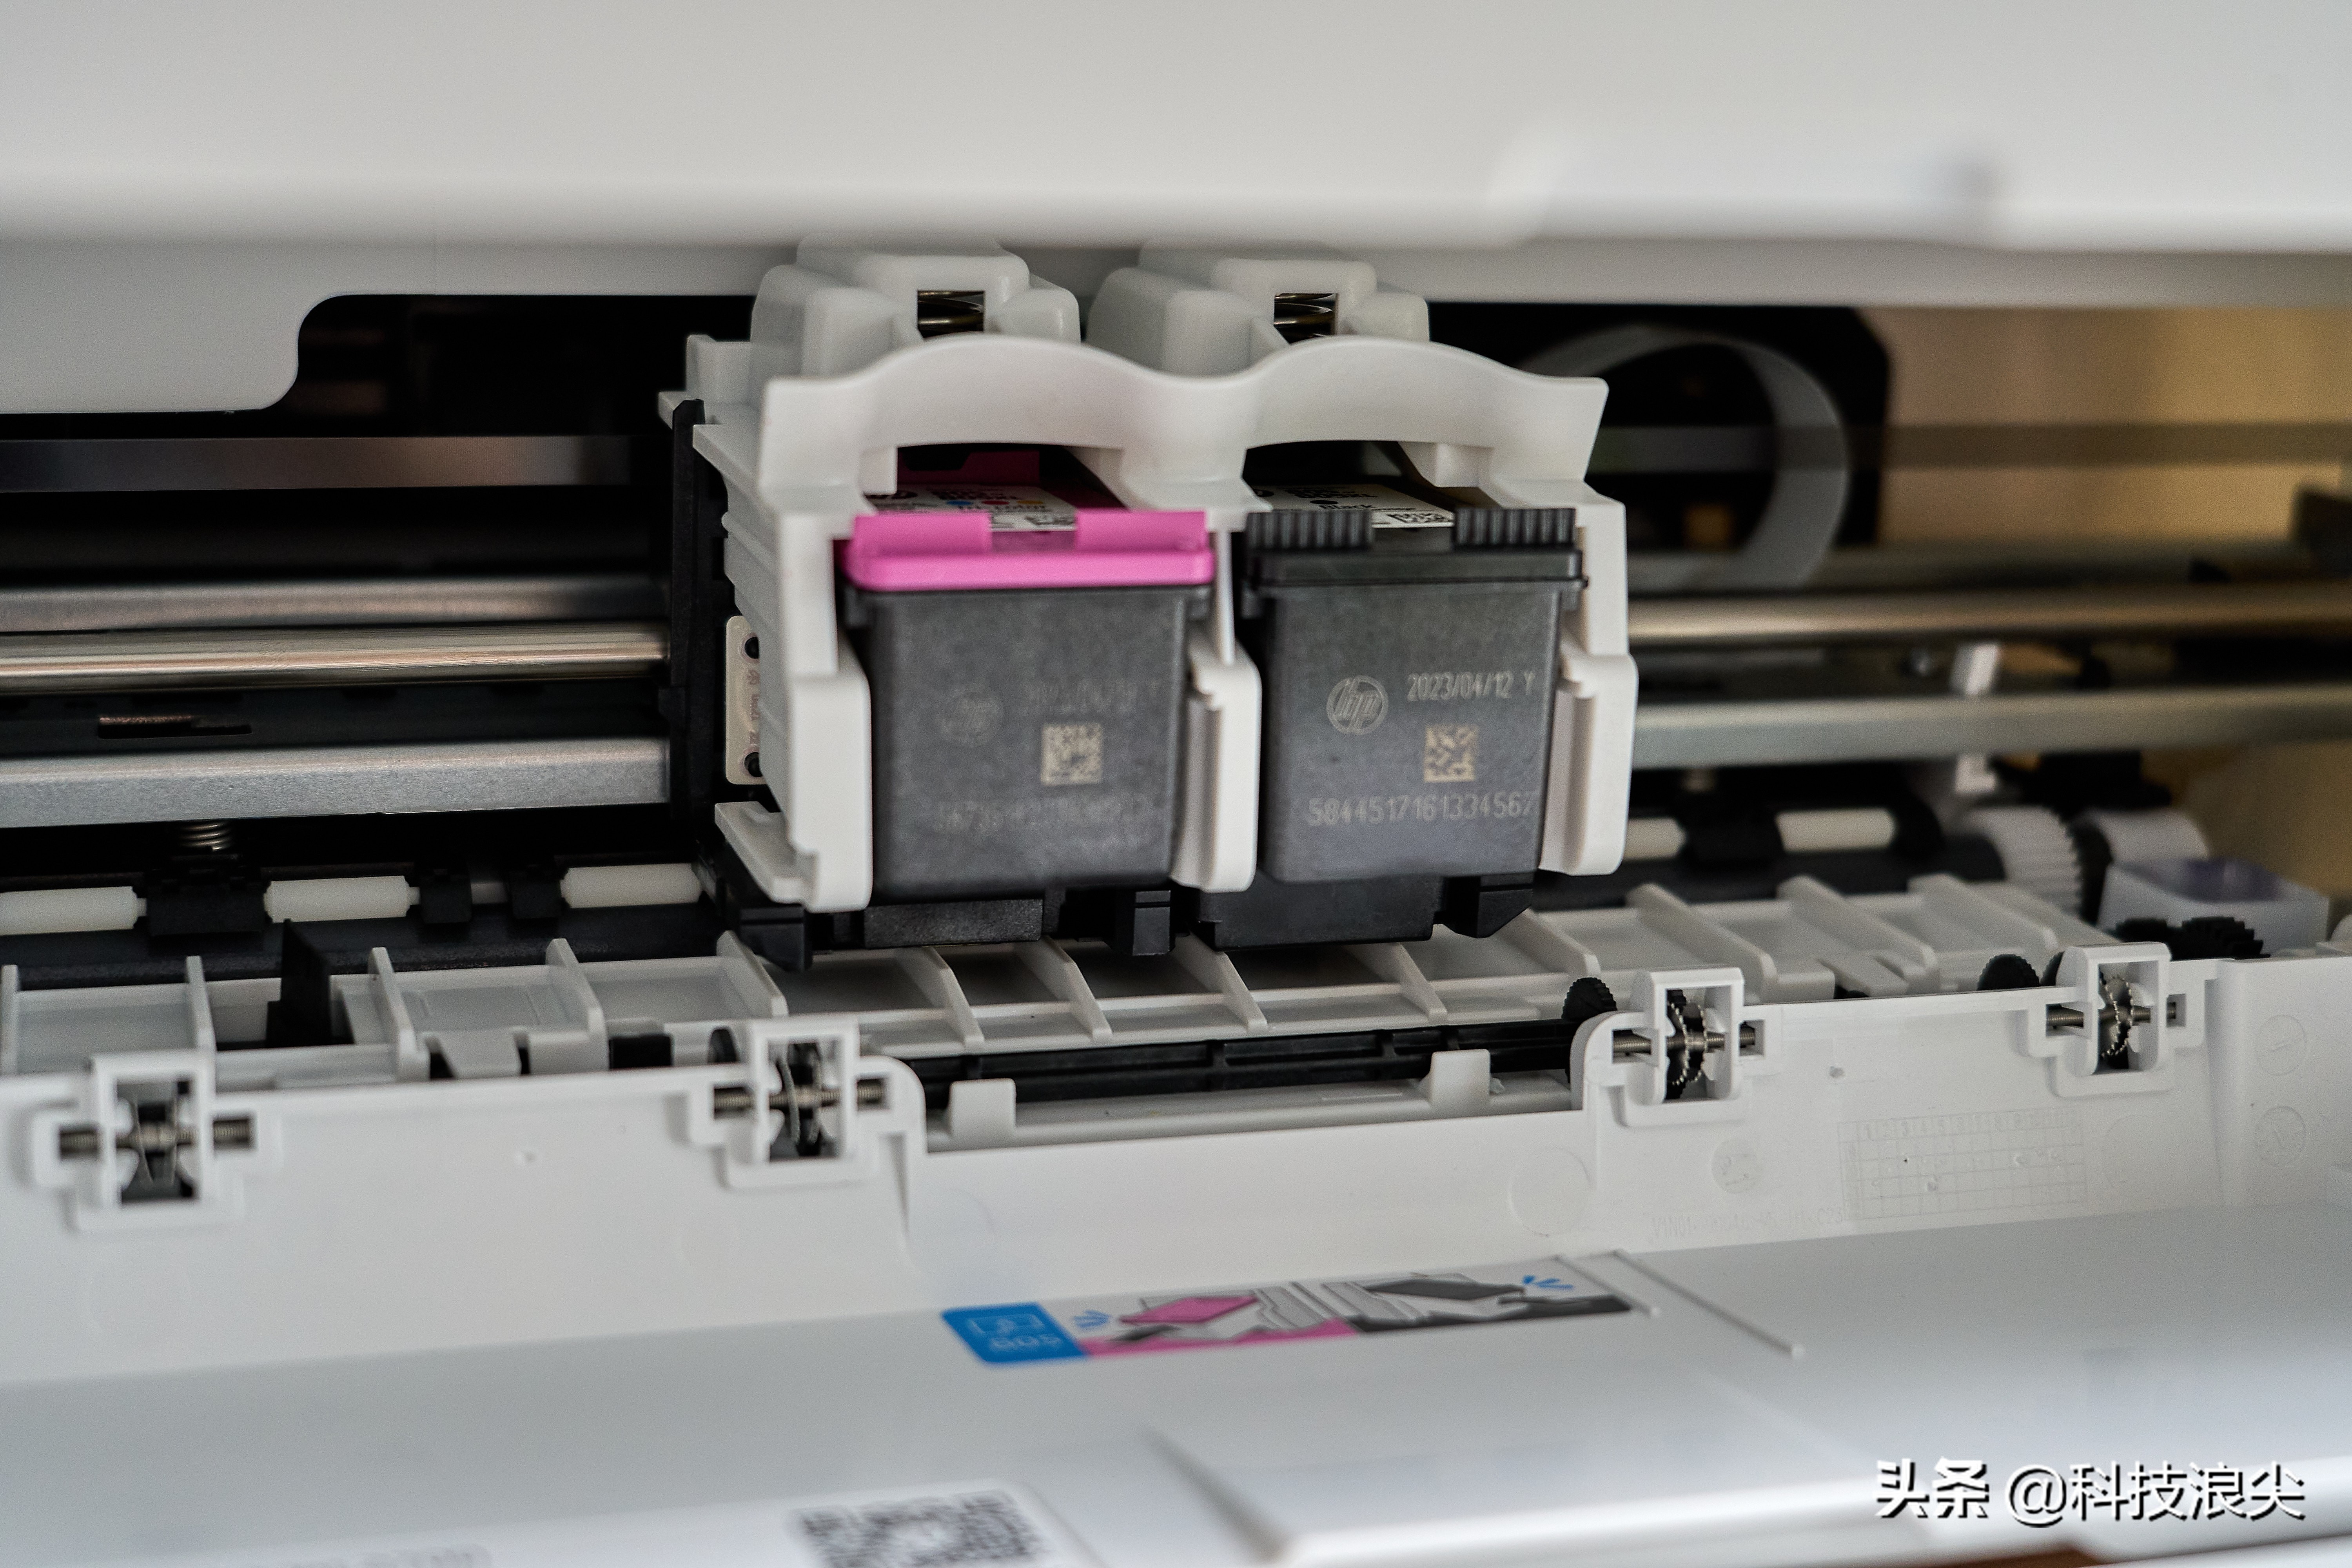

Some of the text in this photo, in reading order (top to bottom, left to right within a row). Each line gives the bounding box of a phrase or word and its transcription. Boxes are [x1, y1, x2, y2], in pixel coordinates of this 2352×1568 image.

[1328, 676, 1387, 735] hp
[1407, 670, 1536, 702] 2023/04/12 Y
